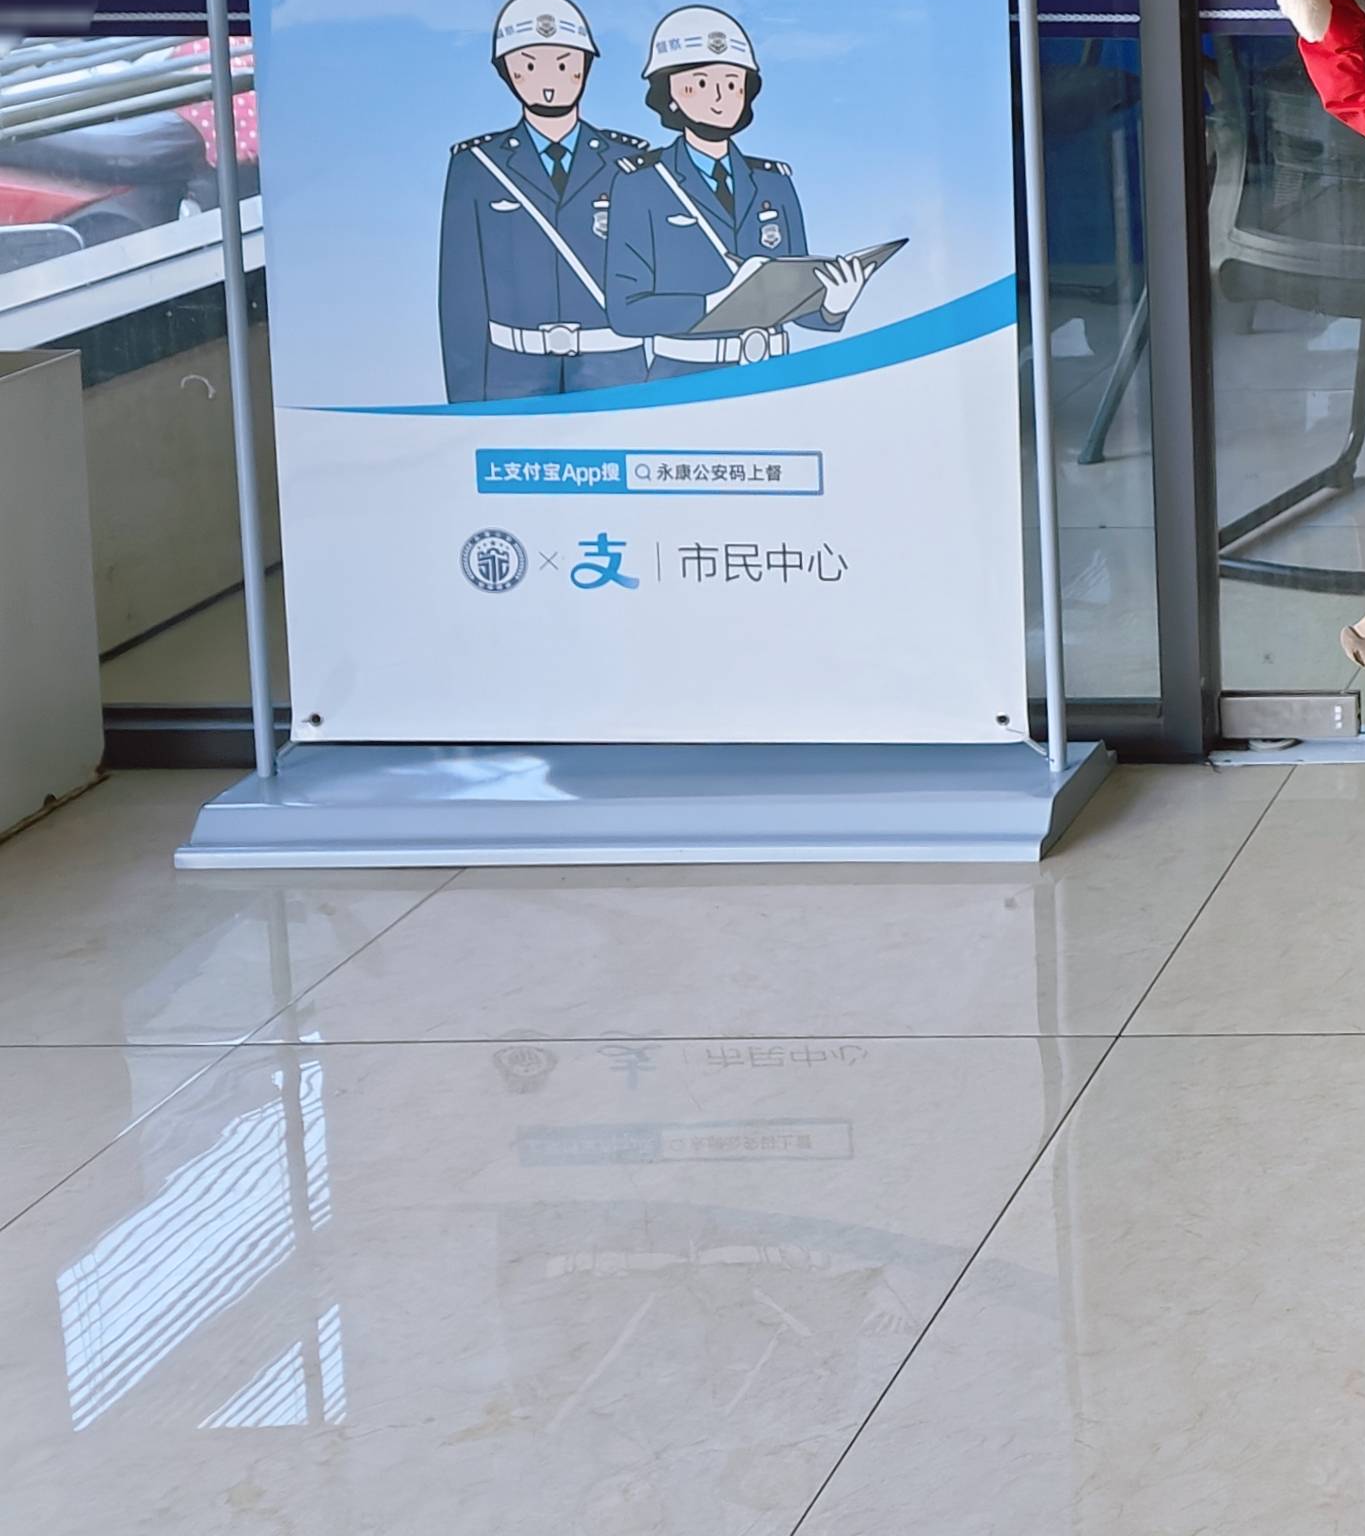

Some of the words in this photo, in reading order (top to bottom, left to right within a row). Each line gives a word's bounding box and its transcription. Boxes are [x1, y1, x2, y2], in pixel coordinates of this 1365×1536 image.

[484, 462, 621, 486] 上支付宝App搜
[656, 463, 783, 482] 永康公安码上督
[678, 542, 849, 584] 市民中心
